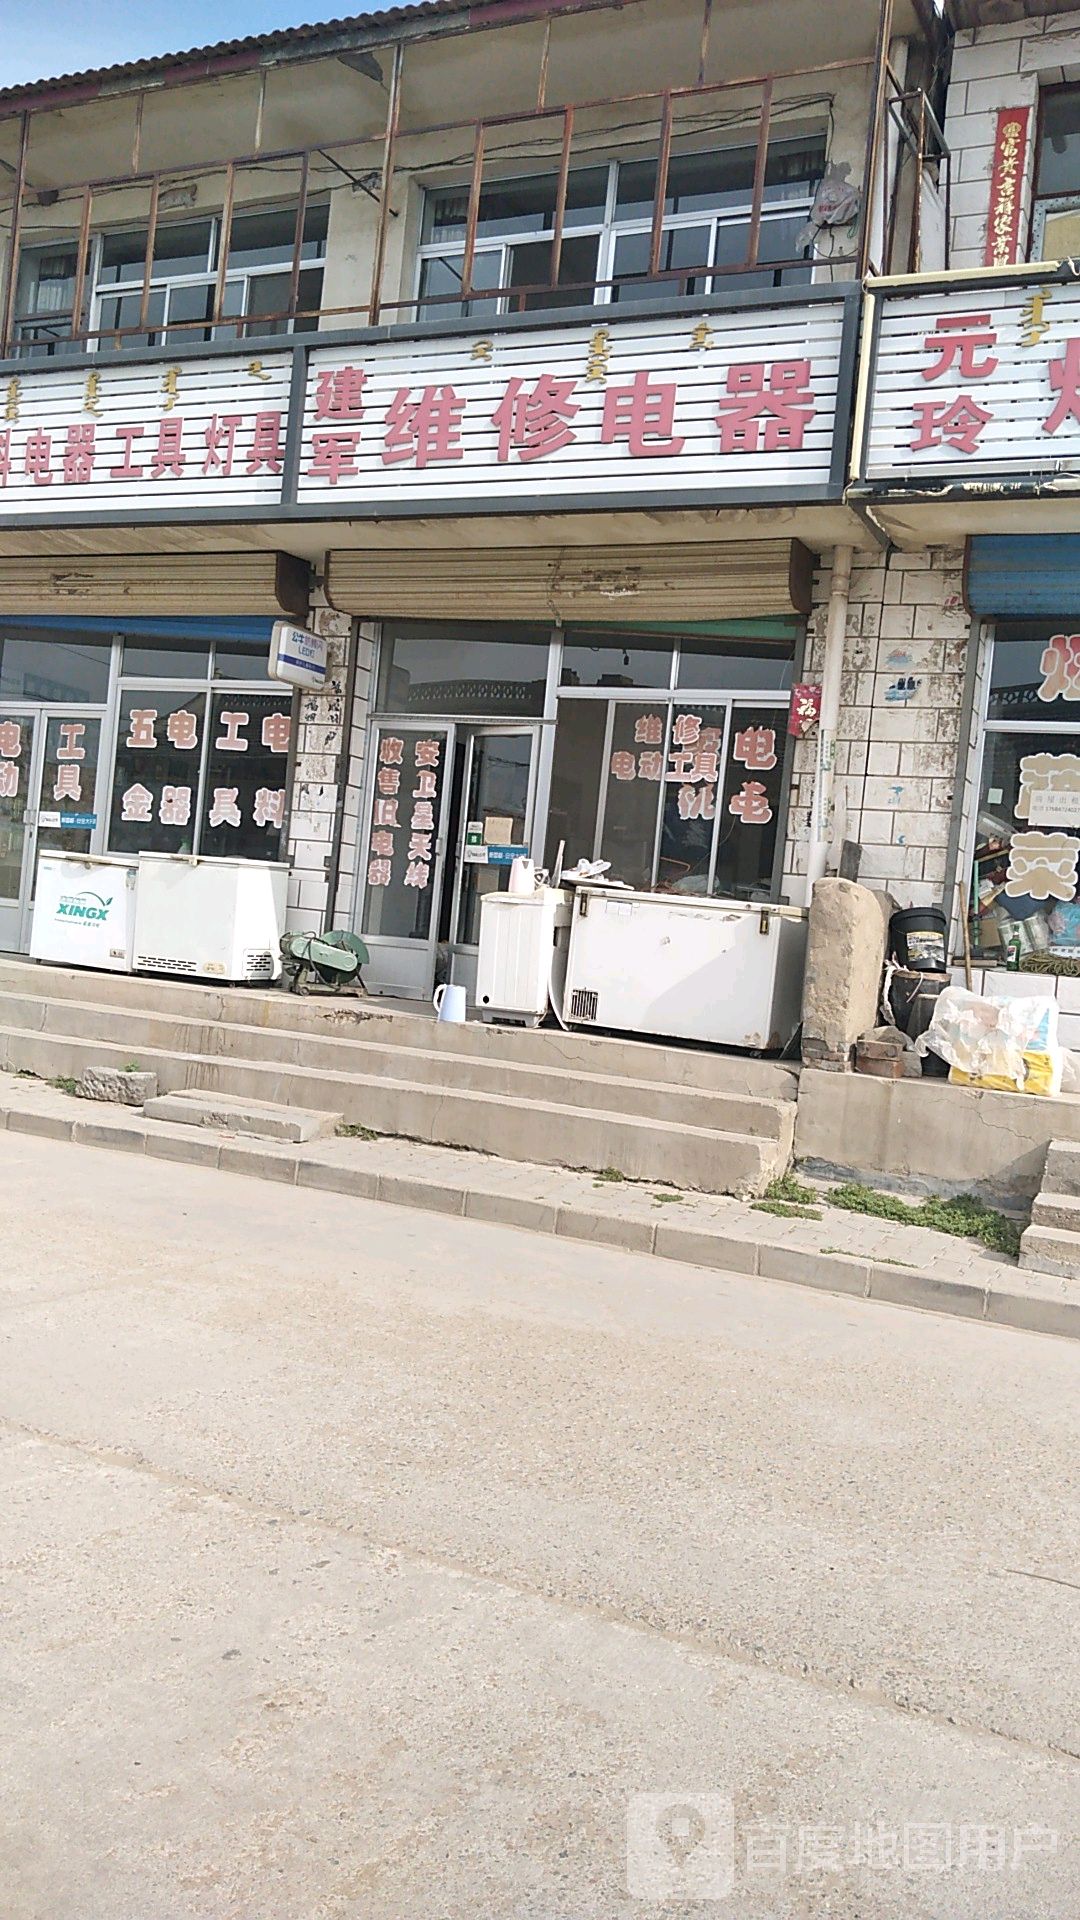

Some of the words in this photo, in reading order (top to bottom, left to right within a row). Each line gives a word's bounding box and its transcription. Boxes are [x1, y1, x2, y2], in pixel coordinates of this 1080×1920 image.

[308, 366, 367, 484] 建军
[381, 360, 817, 467] 维修电器
[910, 313, 999, 454] 元玲
[54, 724, 86, 801] 工具
[611, 751, 718, 783] 电动工具
[634, 714, 702, 745] 维修
[368, 737, 404, 886] 收售旧电器
[404, 739, 440, 889] 安卫星天线
[56, 903, 109, 920] XINGX
